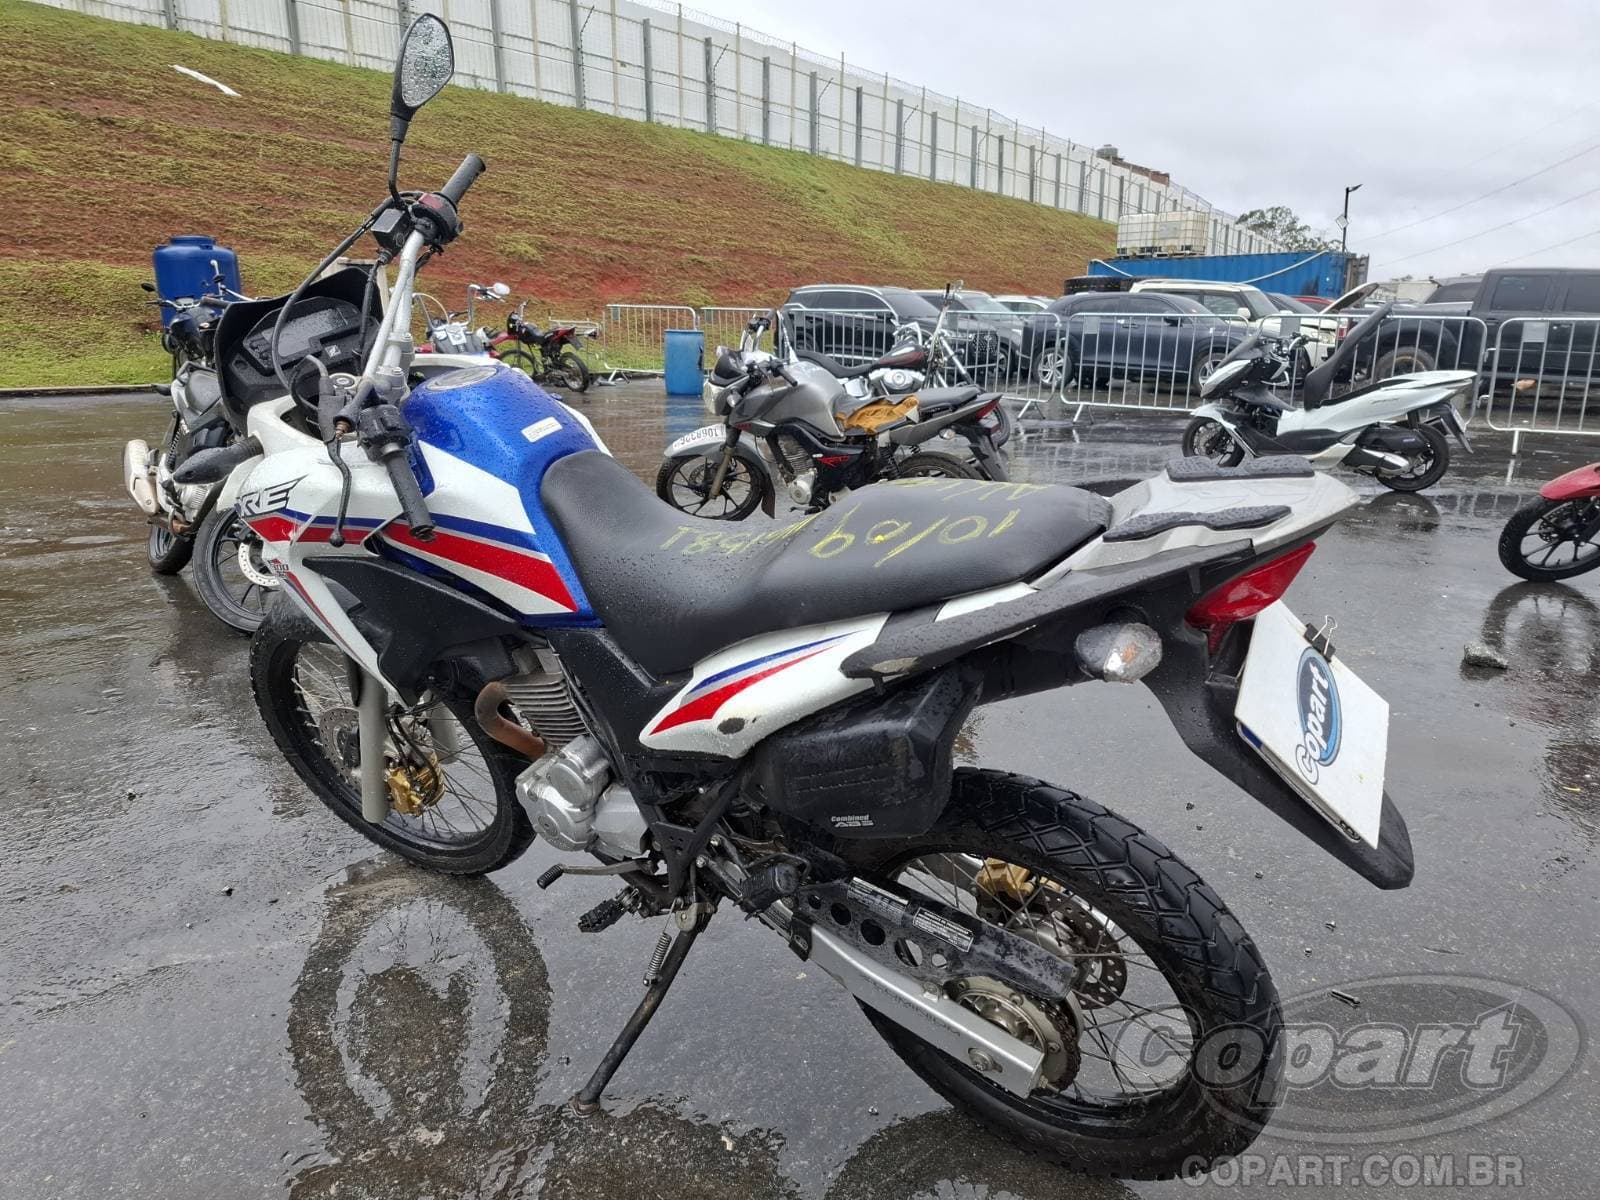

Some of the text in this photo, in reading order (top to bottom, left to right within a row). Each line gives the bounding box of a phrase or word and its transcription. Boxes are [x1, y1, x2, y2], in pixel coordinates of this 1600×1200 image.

[236, 474, 309, 519] RE
[1295, 662, 1330, 786] Copart
[830, 814, 870, 822] Combined
[834, 820, 874, 828] ABS
